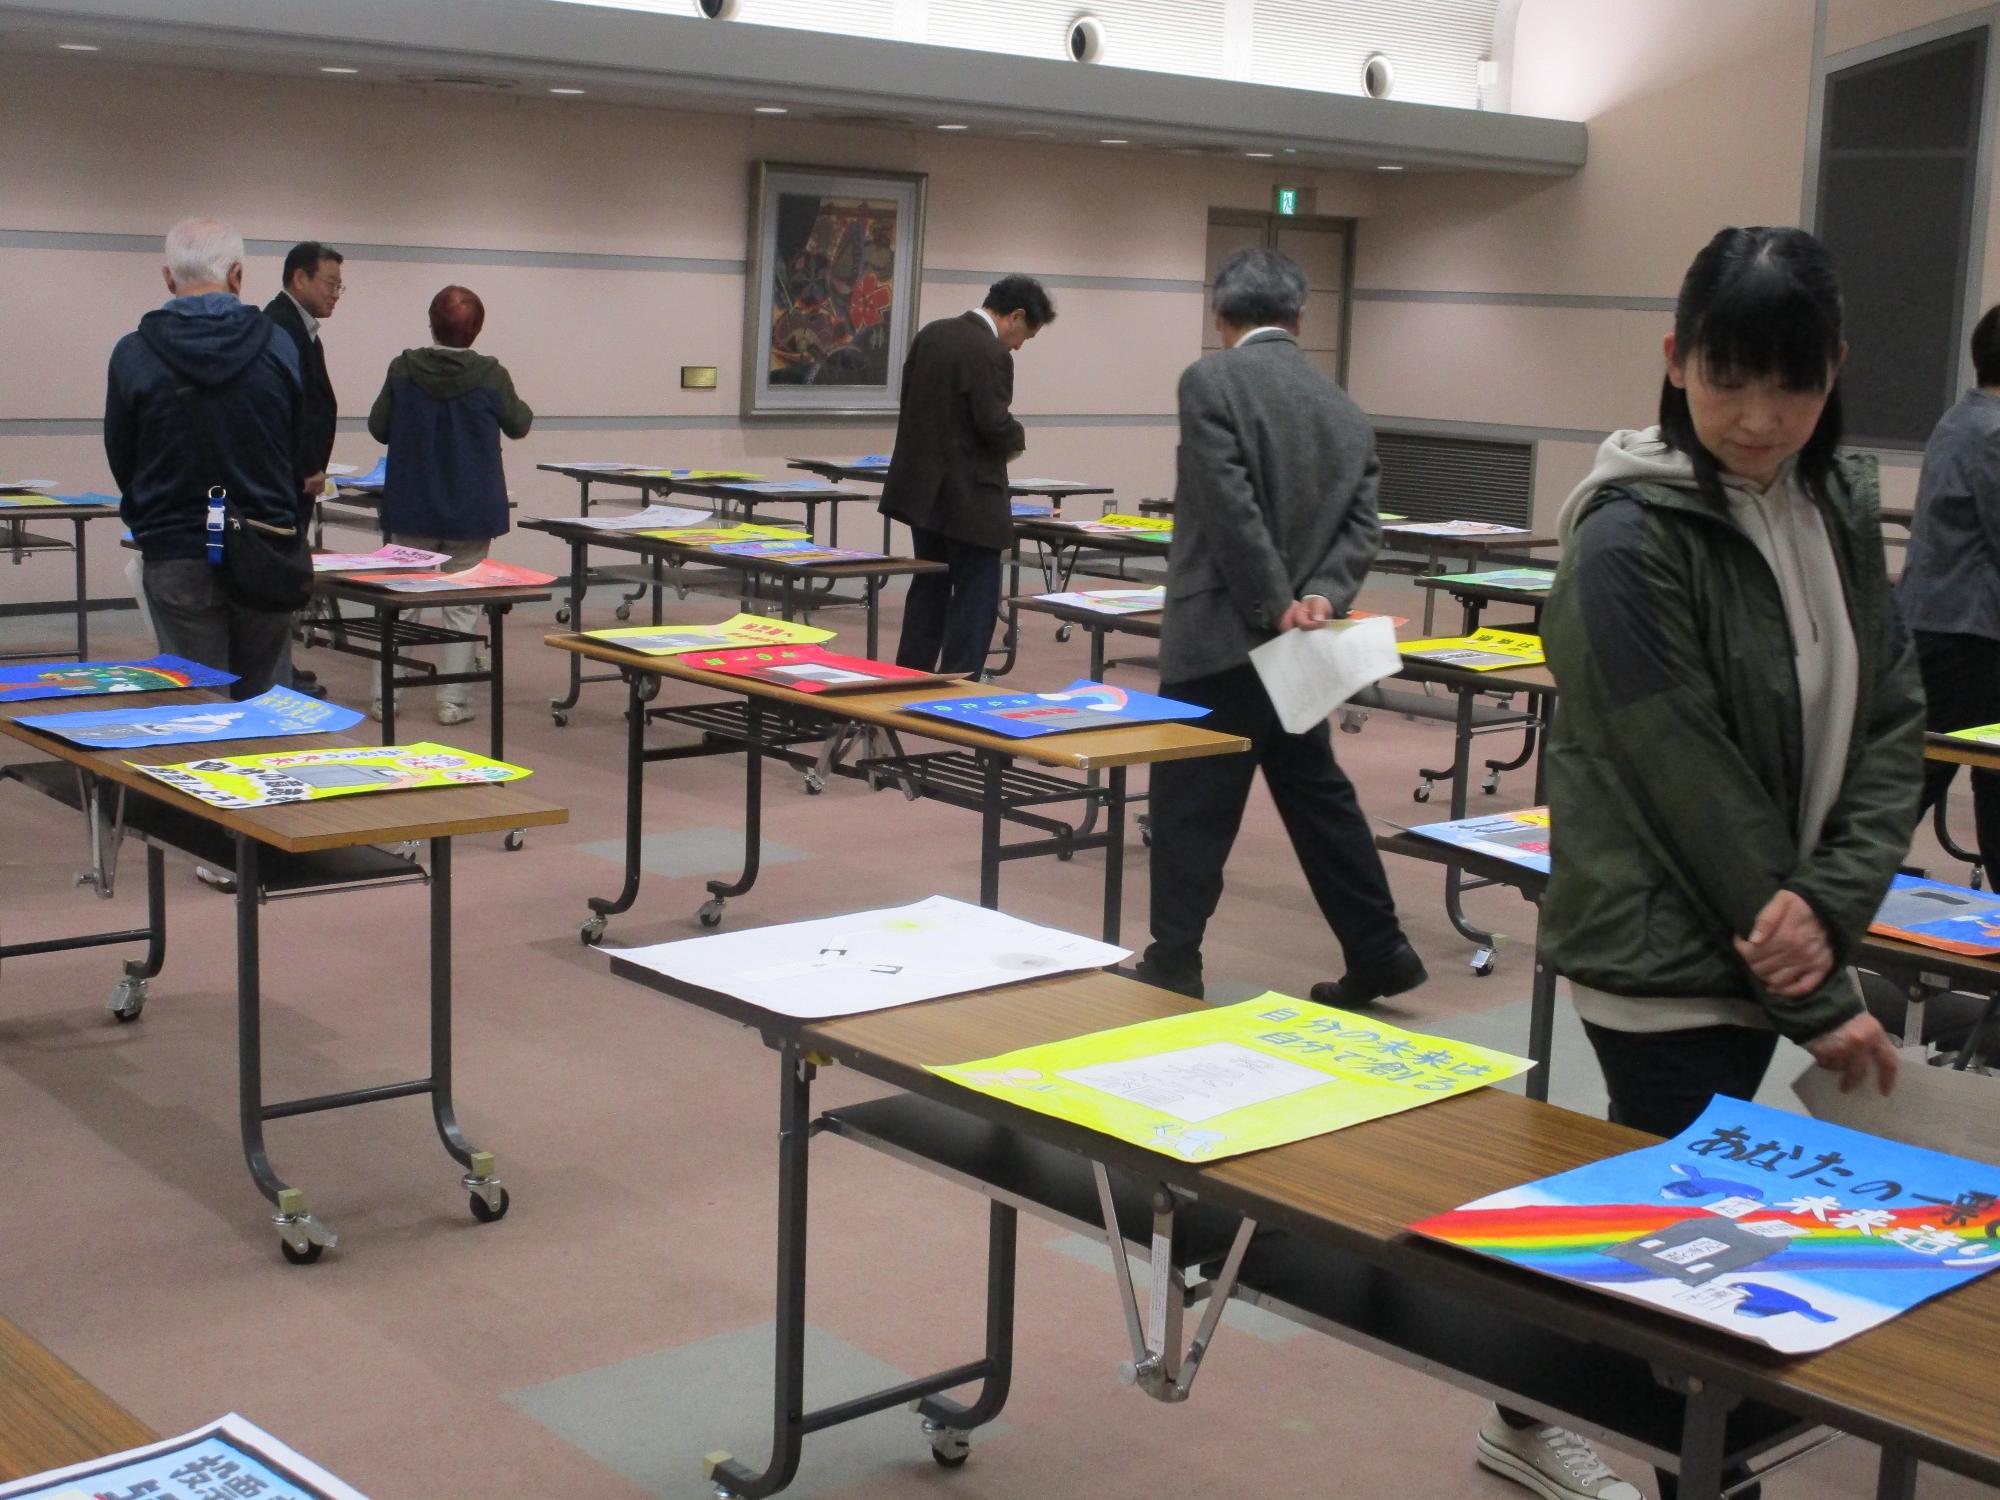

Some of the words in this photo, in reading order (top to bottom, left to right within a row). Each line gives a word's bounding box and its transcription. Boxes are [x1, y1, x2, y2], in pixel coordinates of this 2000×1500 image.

[1254, 1031, 1460, 1091] 自分で創る
[1257, 1007, 1494, 1076] 自分の未来は
